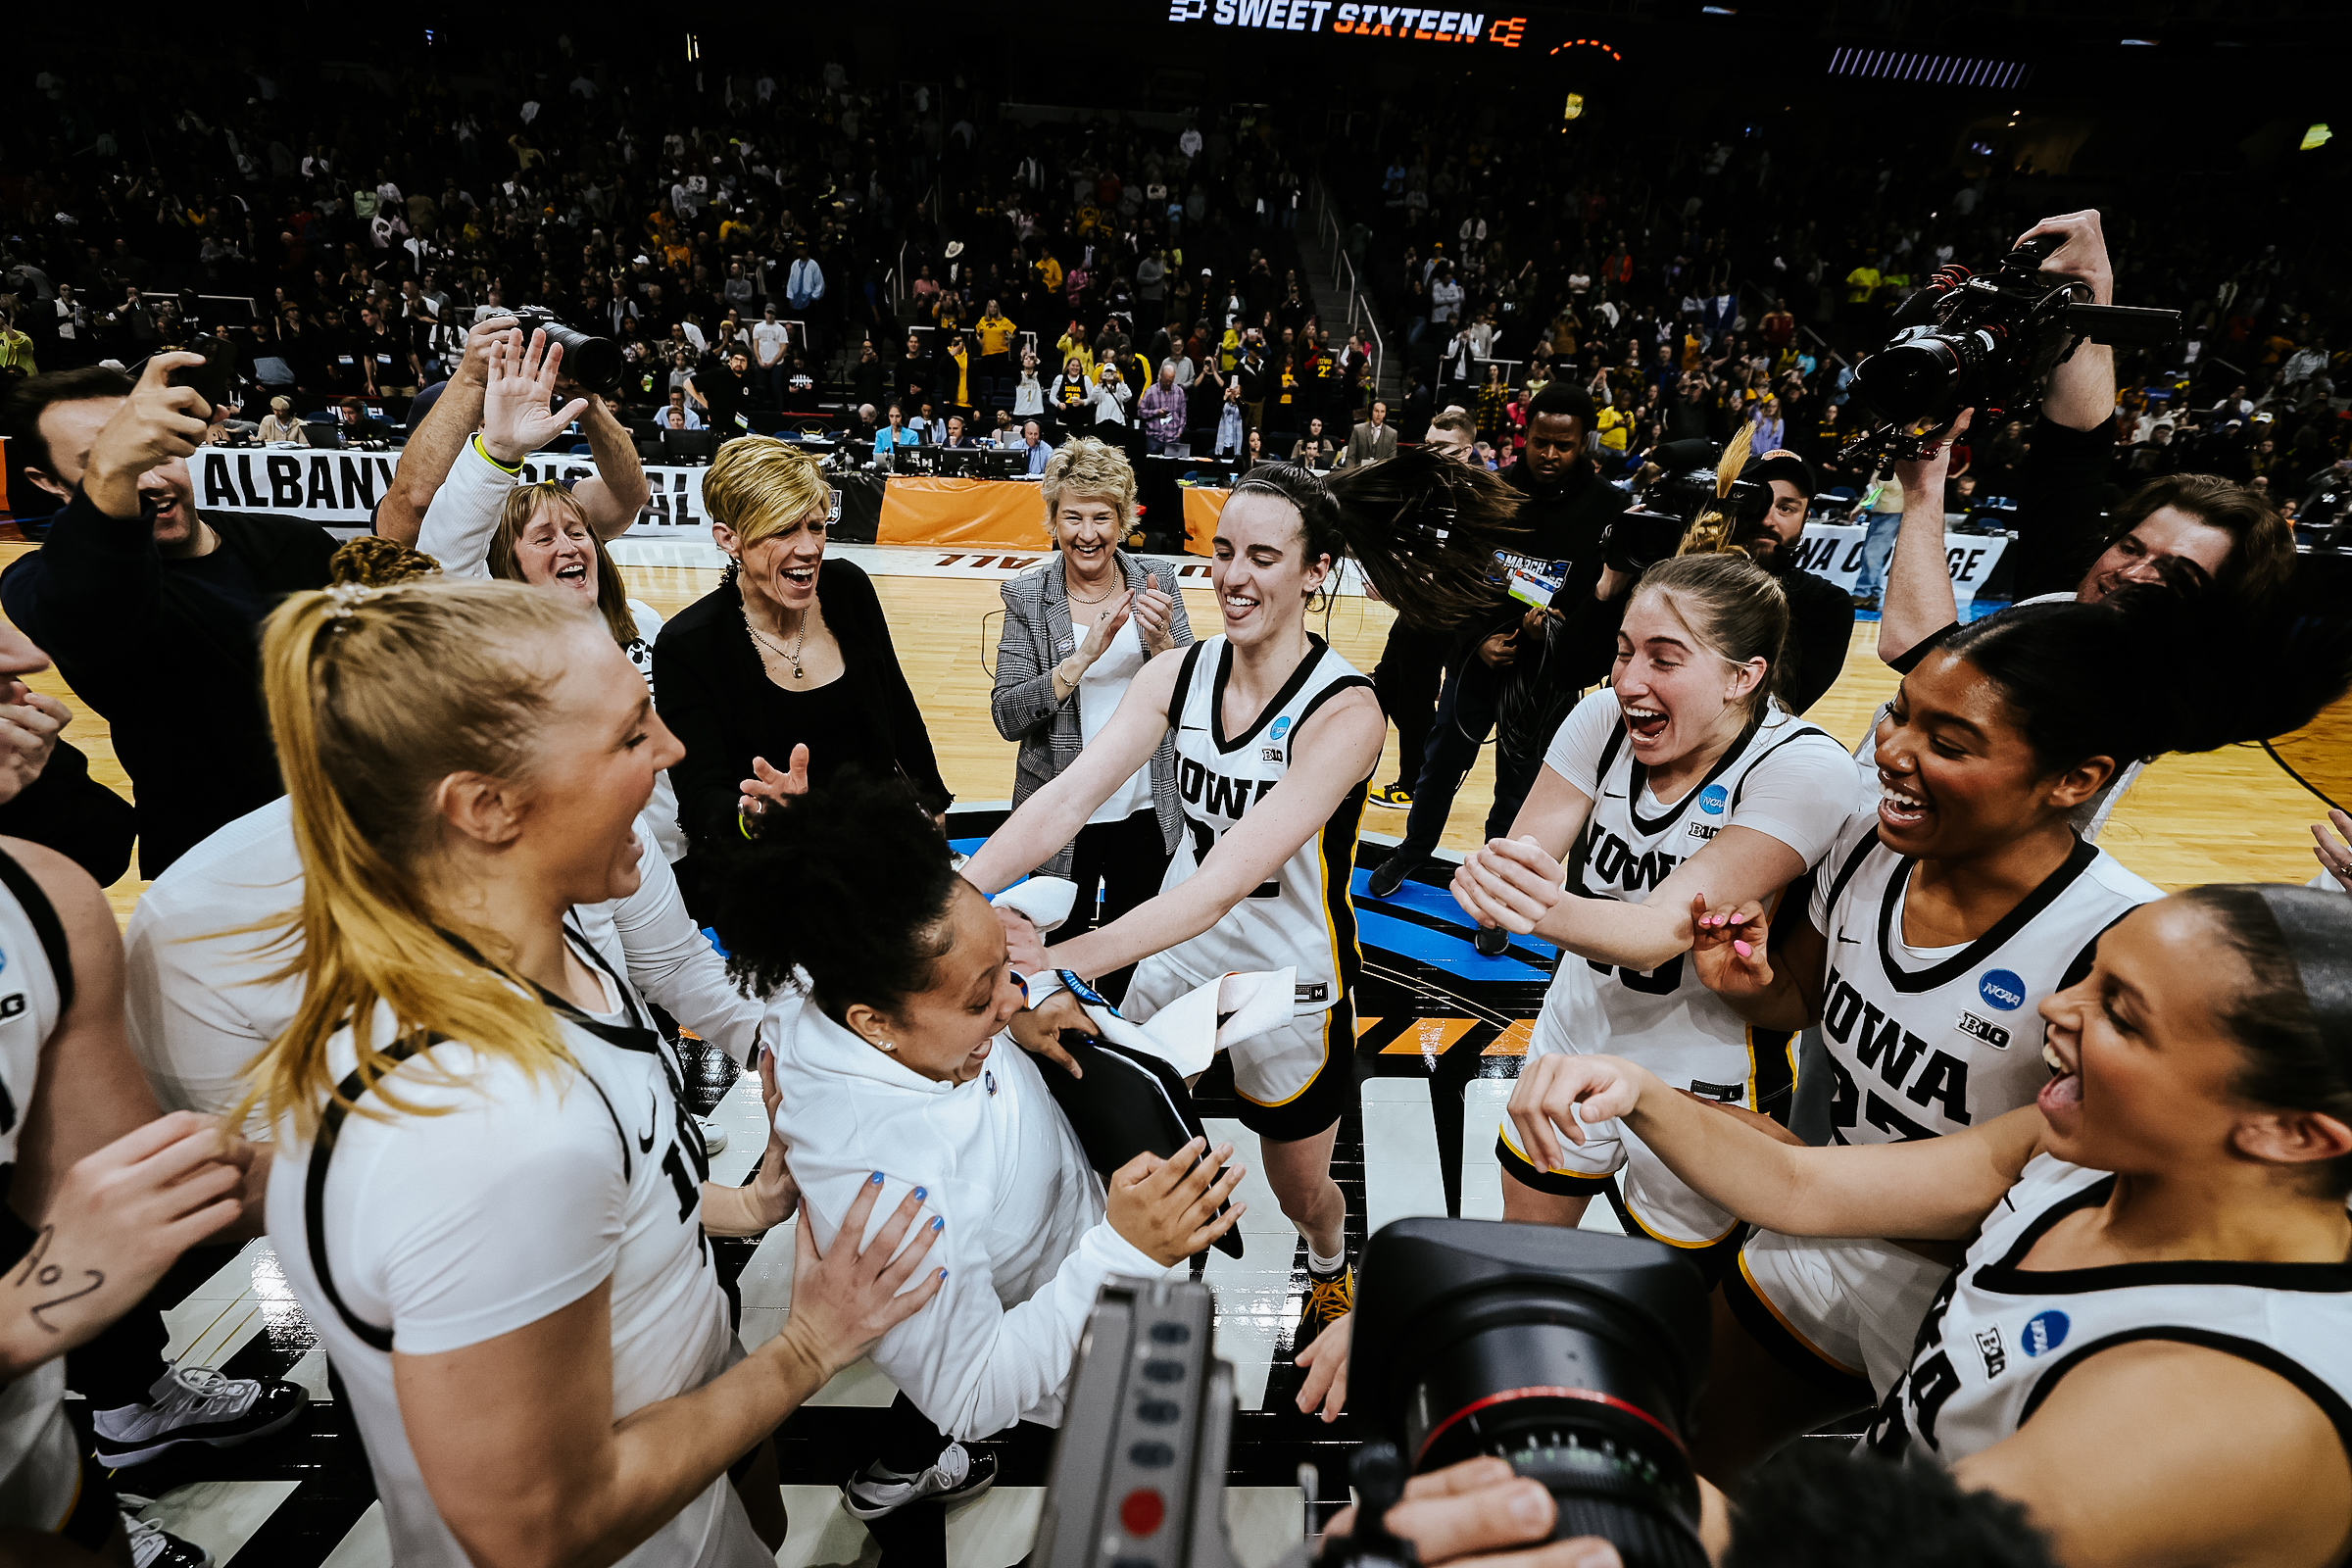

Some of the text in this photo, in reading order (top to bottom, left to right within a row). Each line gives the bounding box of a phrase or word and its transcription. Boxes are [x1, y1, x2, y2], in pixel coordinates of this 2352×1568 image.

[1213, 0, 1484, 43] SWEET SIXTEEN
[1503, 554, 1547, 574] MARCH
[1983, 982, 2021, 1006] NCAA
